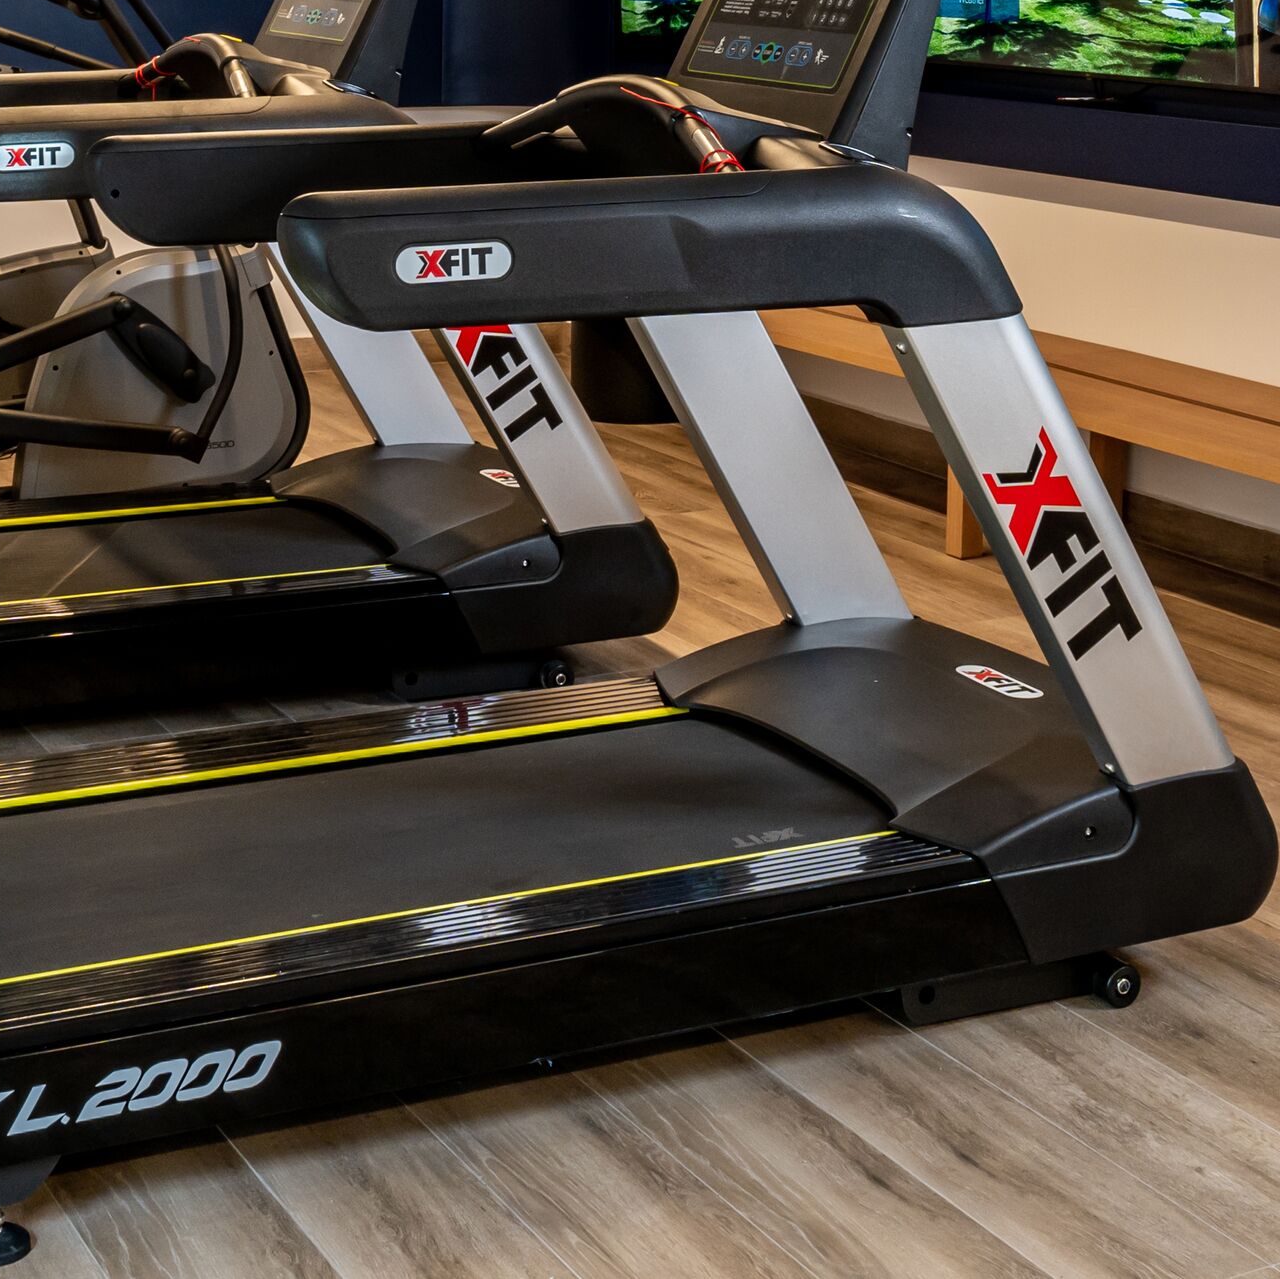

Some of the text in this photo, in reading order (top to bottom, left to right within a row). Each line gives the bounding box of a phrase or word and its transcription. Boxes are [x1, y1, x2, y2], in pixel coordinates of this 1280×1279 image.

[5, 146, 61, 168] XFIT
[415, 246, 493, 280] XFIT
[982, 425, 1143, 662] XFIT
[961, 667, 1038, 694] XFIT
